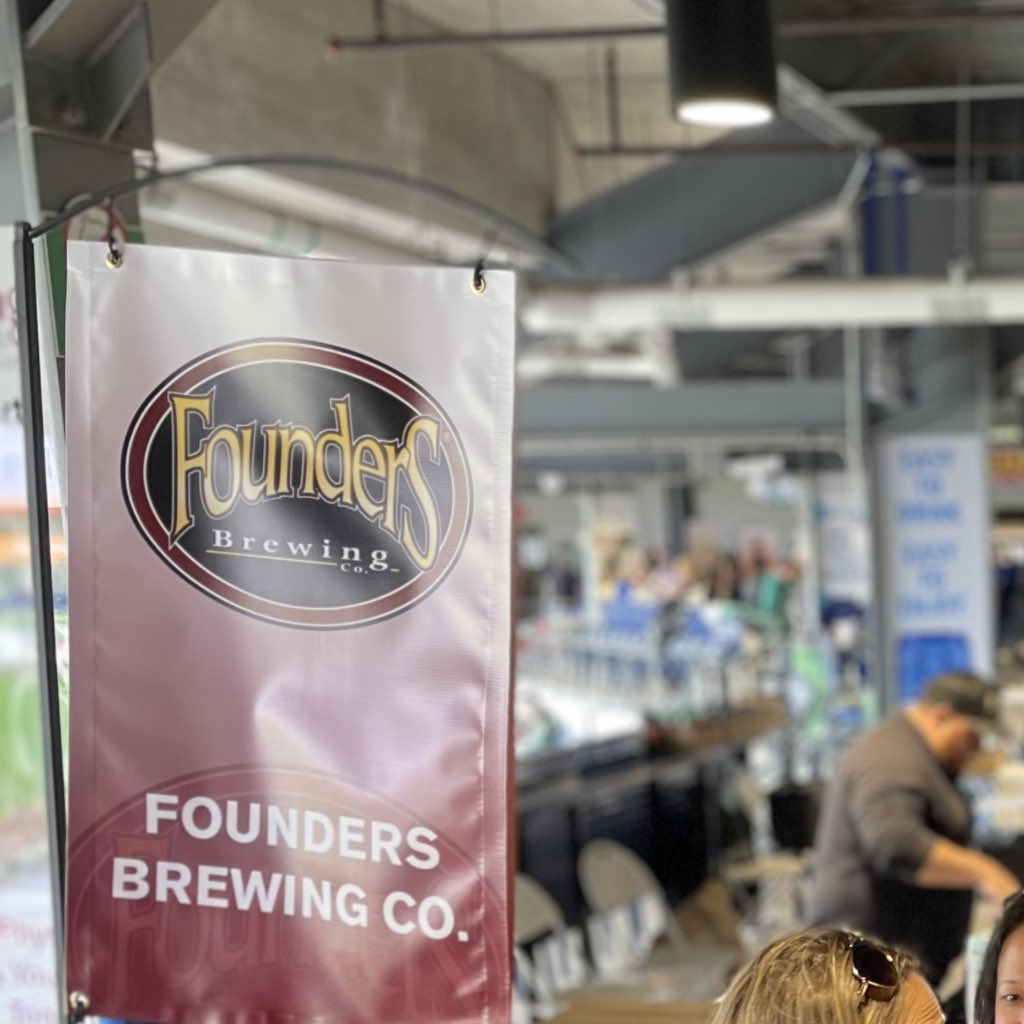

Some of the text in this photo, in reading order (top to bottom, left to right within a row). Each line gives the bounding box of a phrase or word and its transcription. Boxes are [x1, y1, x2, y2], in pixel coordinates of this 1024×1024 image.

[212, 528, 389, 571] Brewing
[341, 563, 368, 574] Co.
[145, 793, 440, 870] FOUNDERS
[111, 857, 469, 943] BREWING CO.
